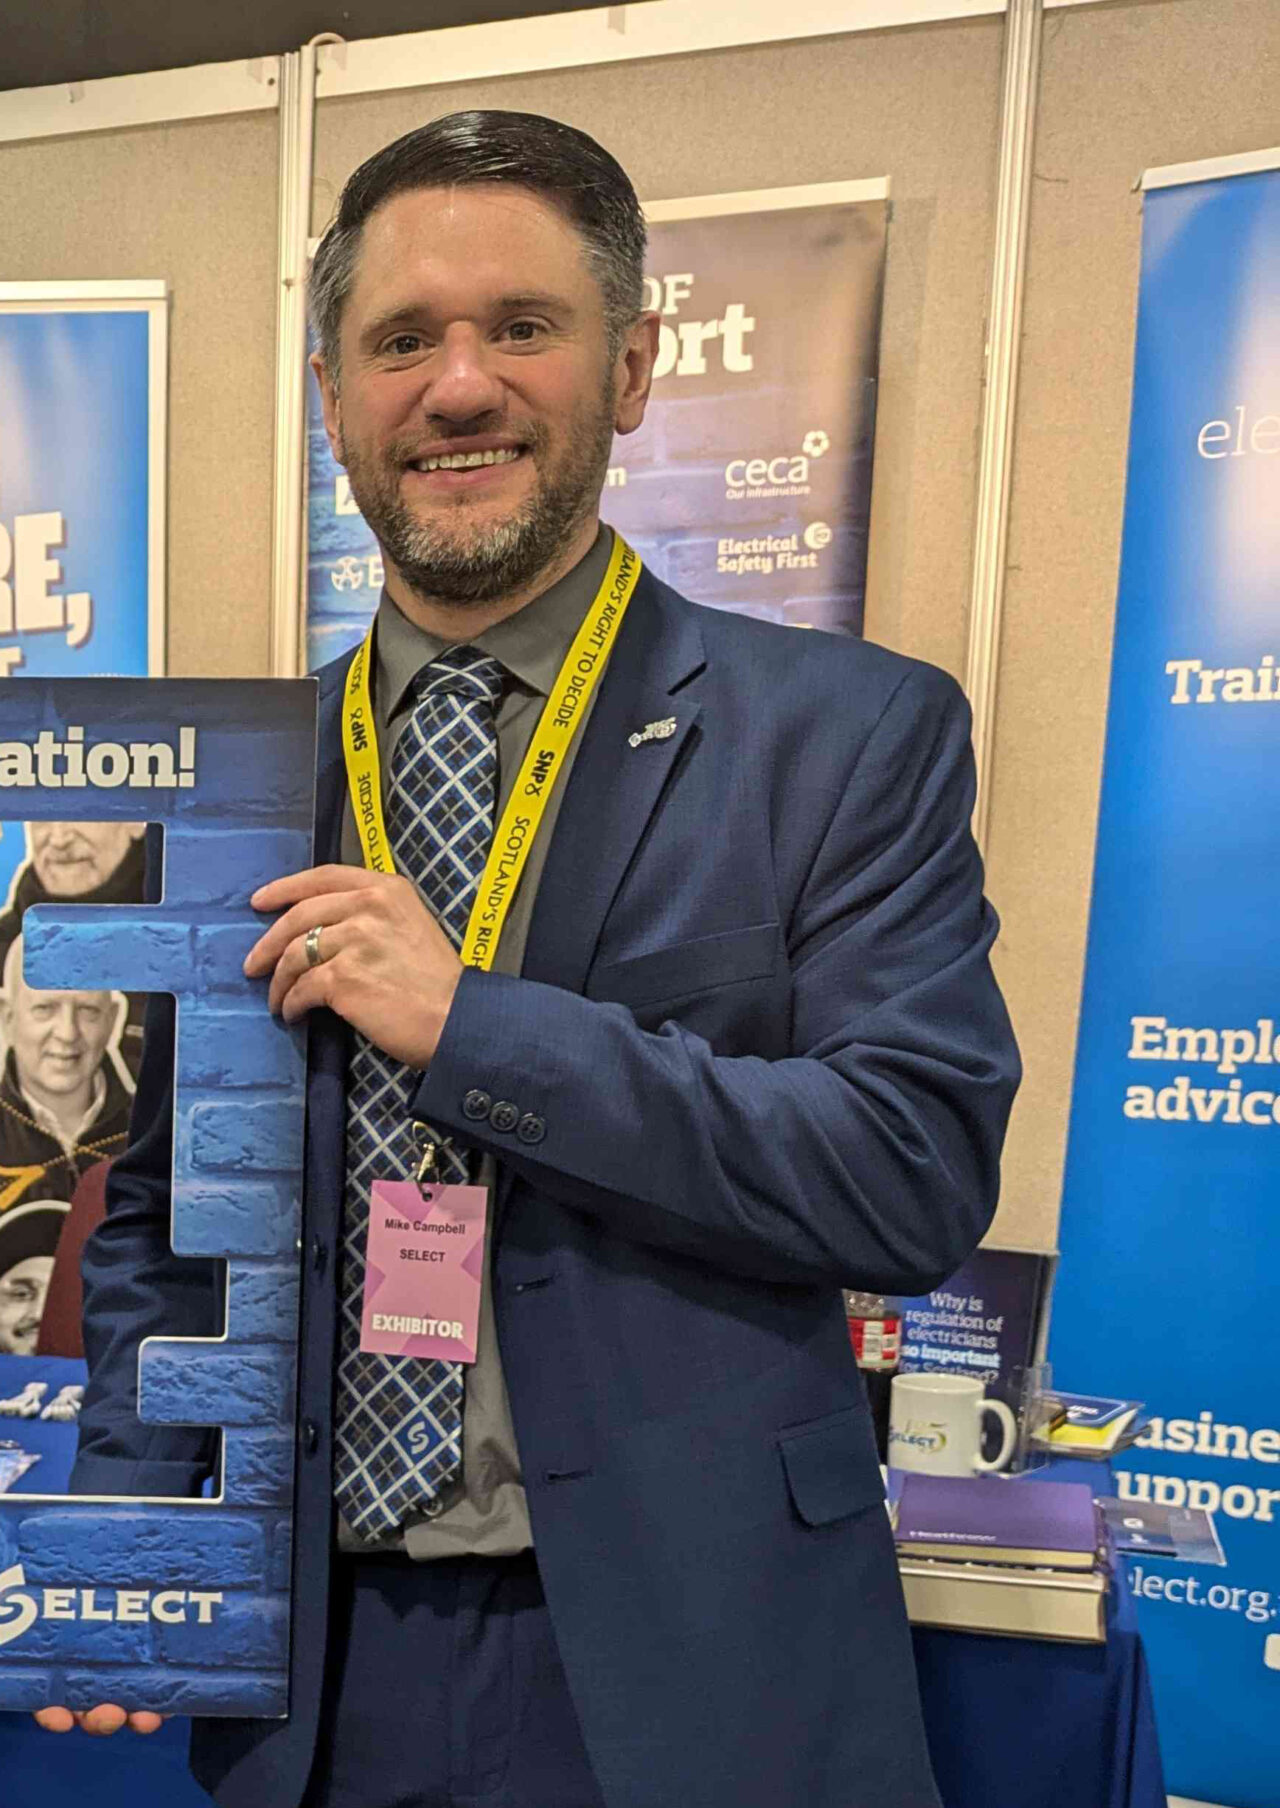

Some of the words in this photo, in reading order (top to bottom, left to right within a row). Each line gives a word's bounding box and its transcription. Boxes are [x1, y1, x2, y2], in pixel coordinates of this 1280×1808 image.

[725, 456, 809, 487] ceca
[718, 534, 798, 555] Electrical
[718, 555, 773, 575] Safety
[777, 552, 818, 569] First
[588, 601, 617, 648] RIGHT
[576, 648, 599, 674] TO
[1166, 656, 1280, 704] Trai
[553, 674, 587, 729] DECIDE
[350, 718, 369, 752] SNP
[531, 749, 555, 784] SNP
[357, 771, 376, 825] DECIDE
[367, 826, 380, 852] TO
[482, 815, 531, 922] SCOTLAND'S
[1128, 1016, 1280, 1074] Empl
[385, 1219, 410, 1232] Mike
[413, 1221, 466, 1235] Campbell
[400, 1248, 446, 1263] SELECT
[930, 1291, 967, 1312] Why
[969, 1296, 983, 1312] is
[372, 1313, 464, 1338] EXHIBITOR
[906, 1310, 984, 1331] regulation
[986, 1316, 1004, 1333] of
[907, 1327, 998, 1349] electricians
[921, 1343, 1002, 1369] important
